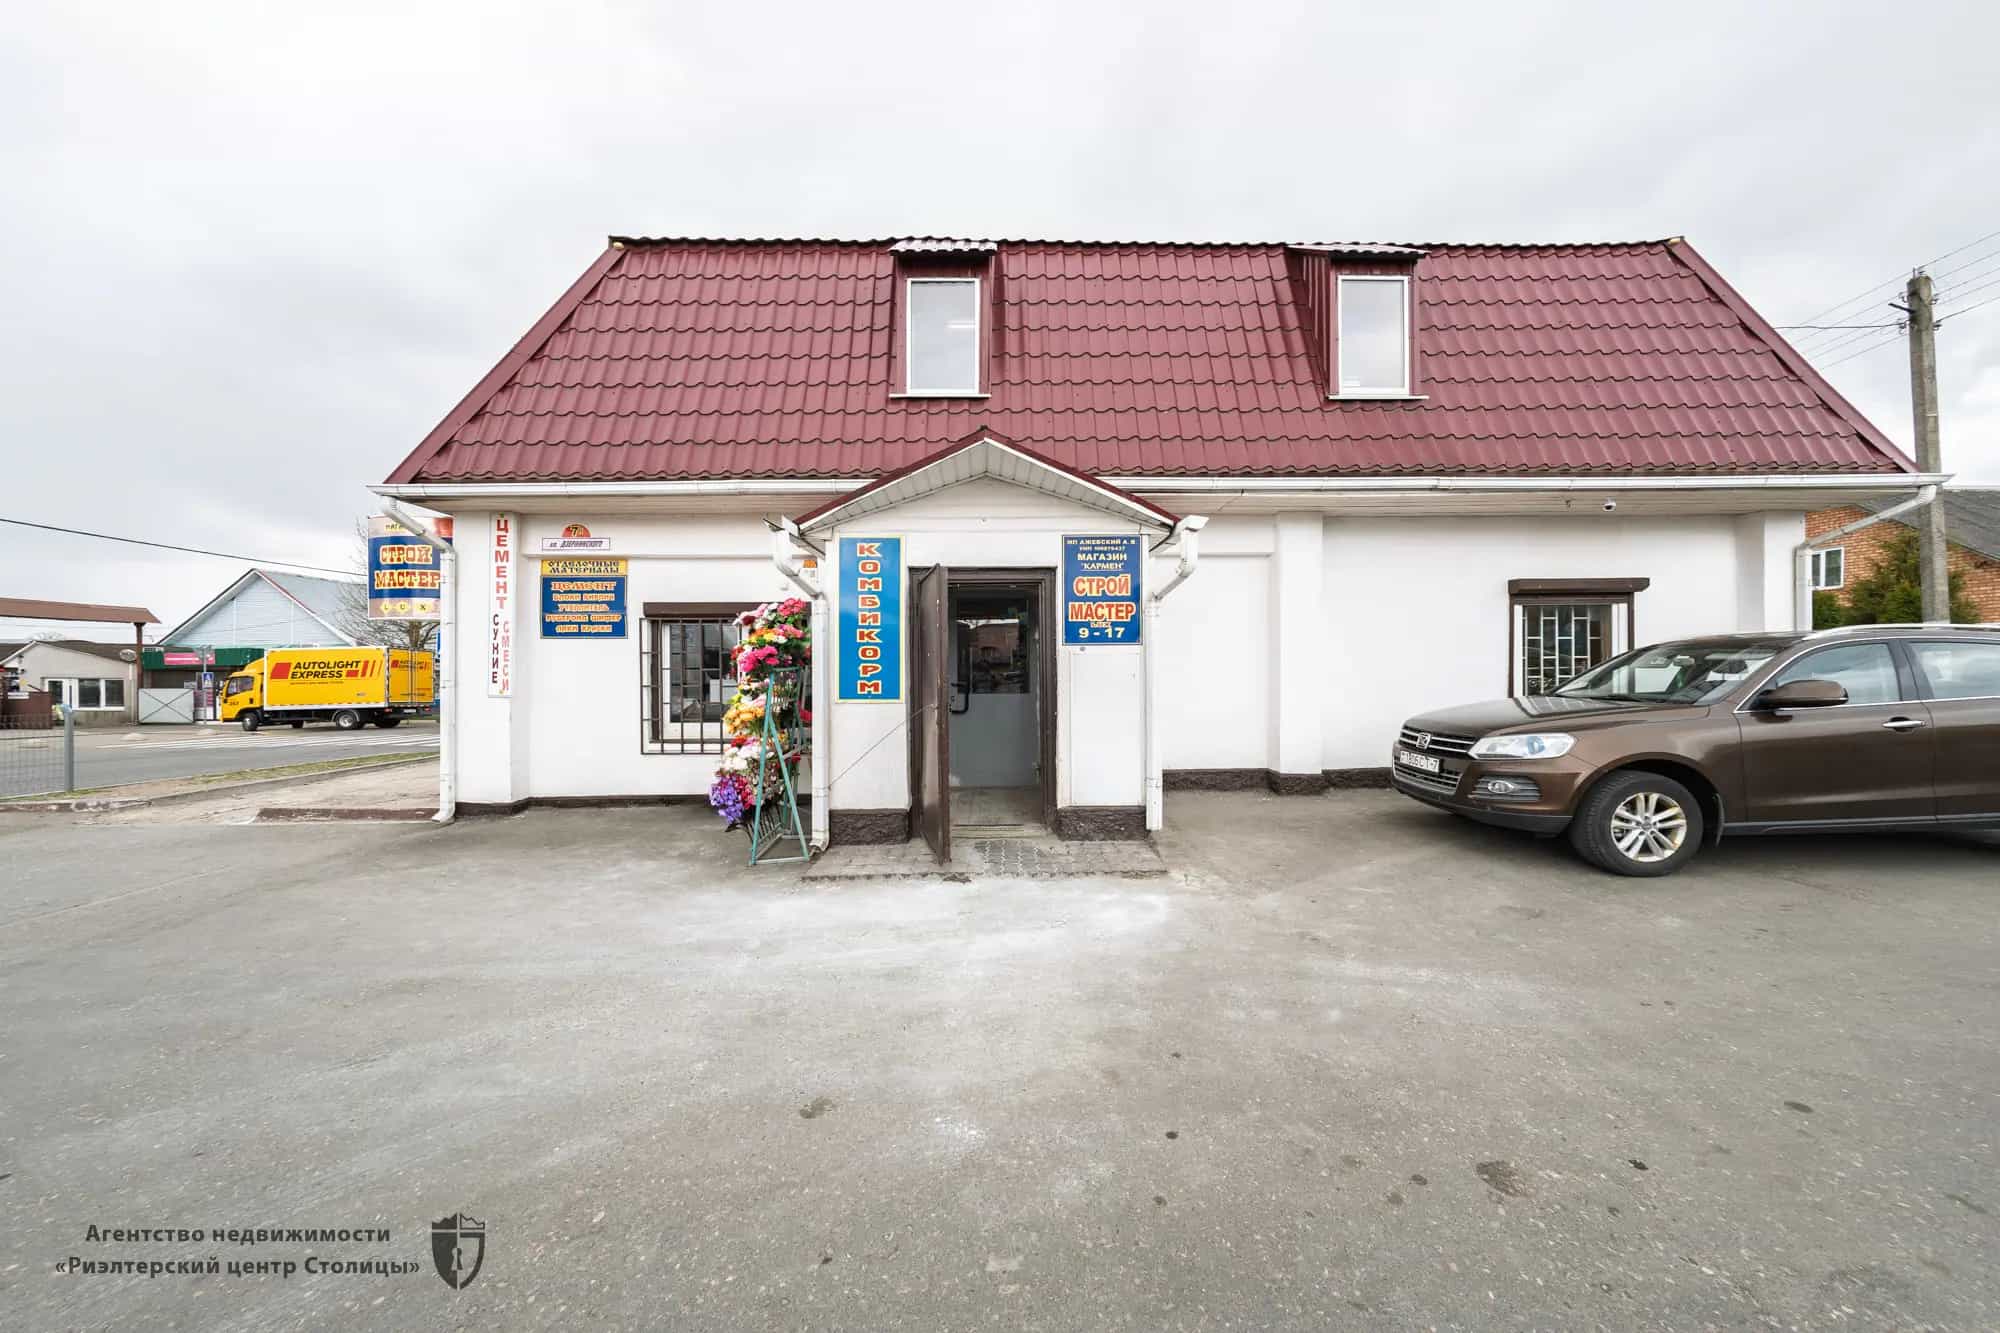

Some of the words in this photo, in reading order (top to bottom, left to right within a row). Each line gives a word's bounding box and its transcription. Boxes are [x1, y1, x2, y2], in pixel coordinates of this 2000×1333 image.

[380, 545, 432, 564] СТРОЙ
[494, 519, 510, 609] ЦЕМЕНТ
[1078, 553, 1127, 561] МАГАЗИН
[374, 569, 440, 590] МАСТЕР
[1073, 573, 1131, 596] СТРОЙ
[857, 543, 882, 694] КОМБИКОРМ
[1068, 601, 1136, 622] МАСТЕР
[294, 660, 360, 670] AUTOLIGHT
[502, 621, 510, 691] СМЕСИ
[291, 670, 343, 679] EXPRESS
